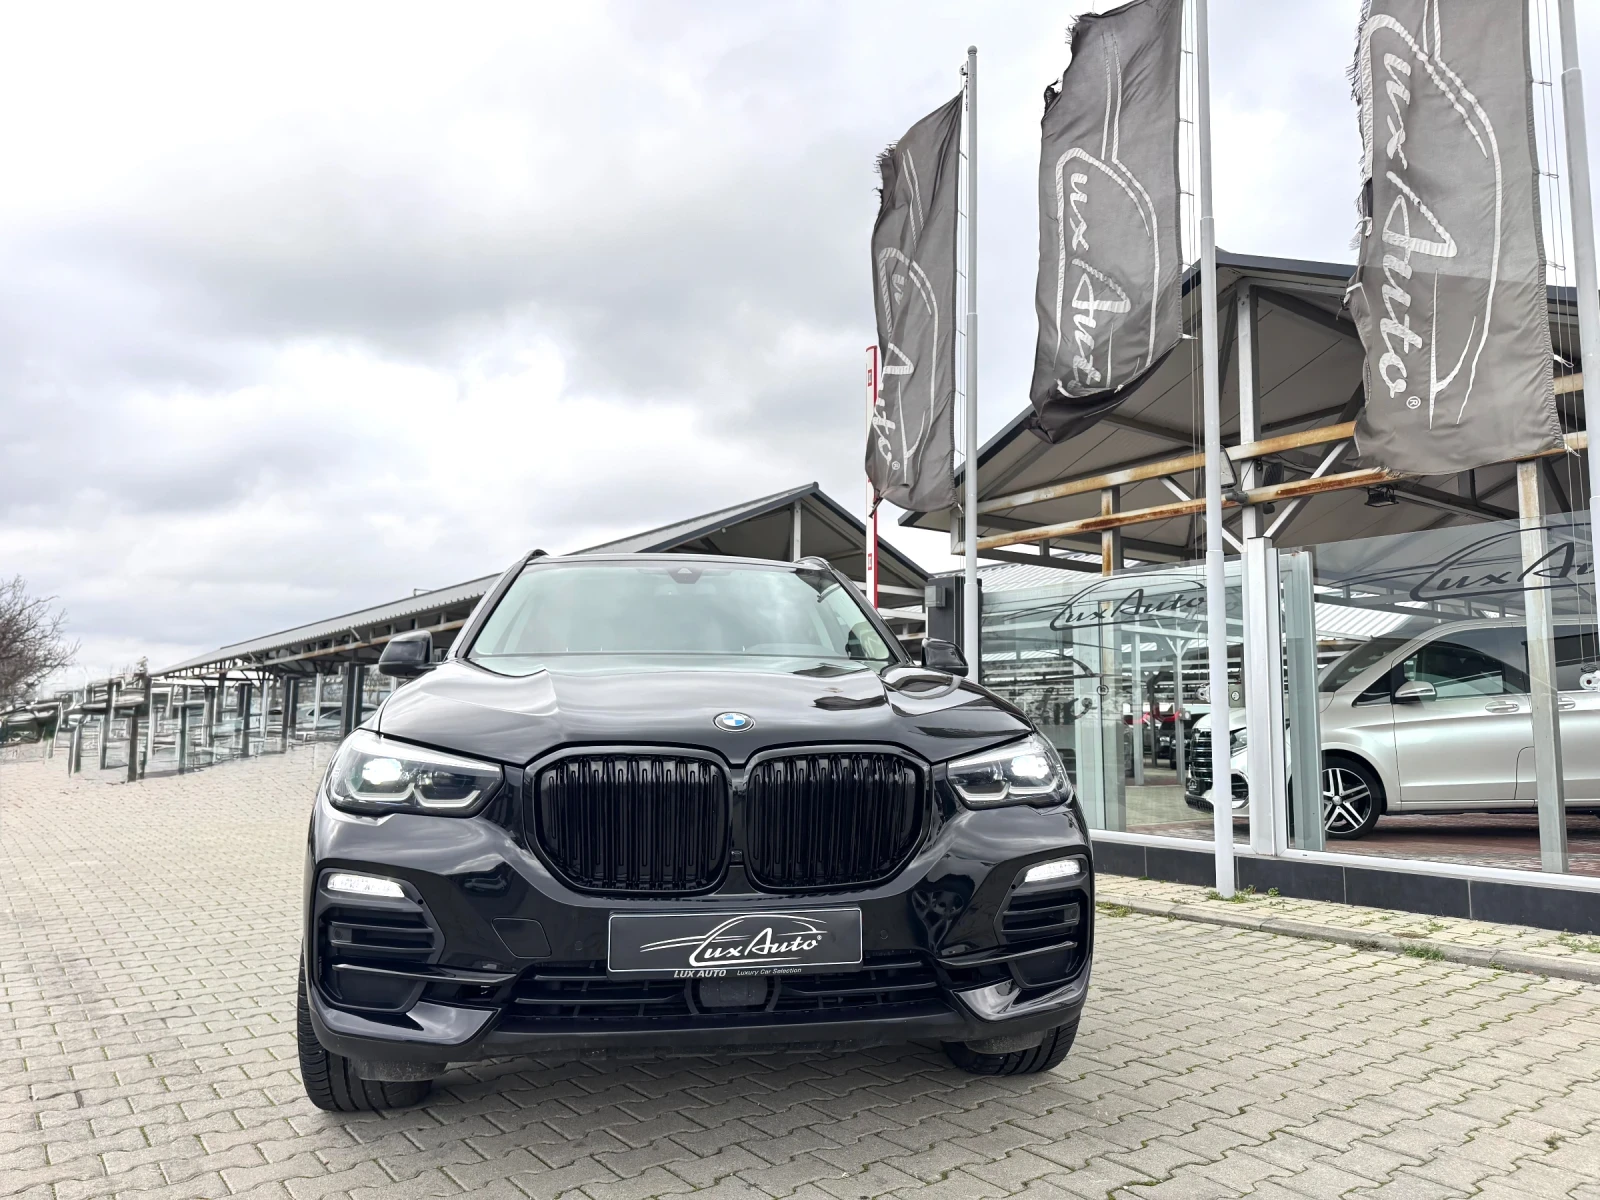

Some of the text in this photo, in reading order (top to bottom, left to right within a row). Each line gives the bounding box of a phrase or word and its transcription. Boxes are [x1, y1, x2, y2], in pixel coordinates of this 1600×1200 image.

[673, 969, 727, 978] LUX AUTO
[772, 967, 802, 975] Selection
